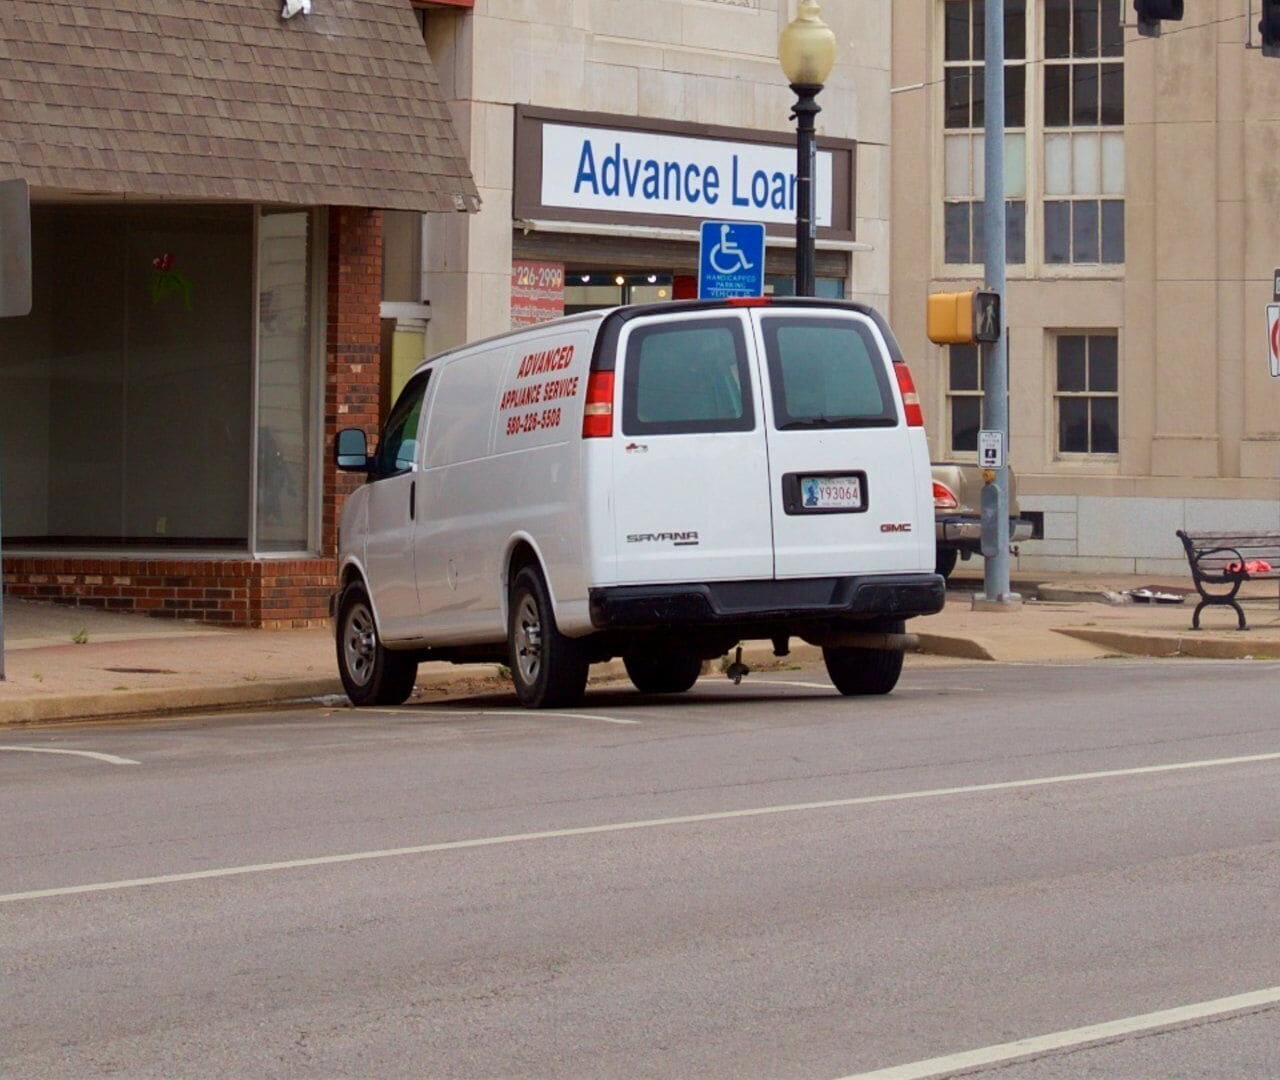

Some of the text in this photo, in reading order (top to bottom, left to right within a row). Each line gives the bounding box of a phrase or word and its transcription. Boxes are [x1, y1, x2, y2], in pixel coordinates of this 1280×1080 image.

[574, 140, 720, 205] Advance
[706, 274, 756, 282] HANDICAPPED
[516, 345, 575, 379] ADVANCED
[500, 377, 579, 411] APPLIANCE SERVICE
[819, 487, 858, 500] Y93064
[880, 523, 911, 533] GMC
[626, 532, 699, 543] SAVANA
